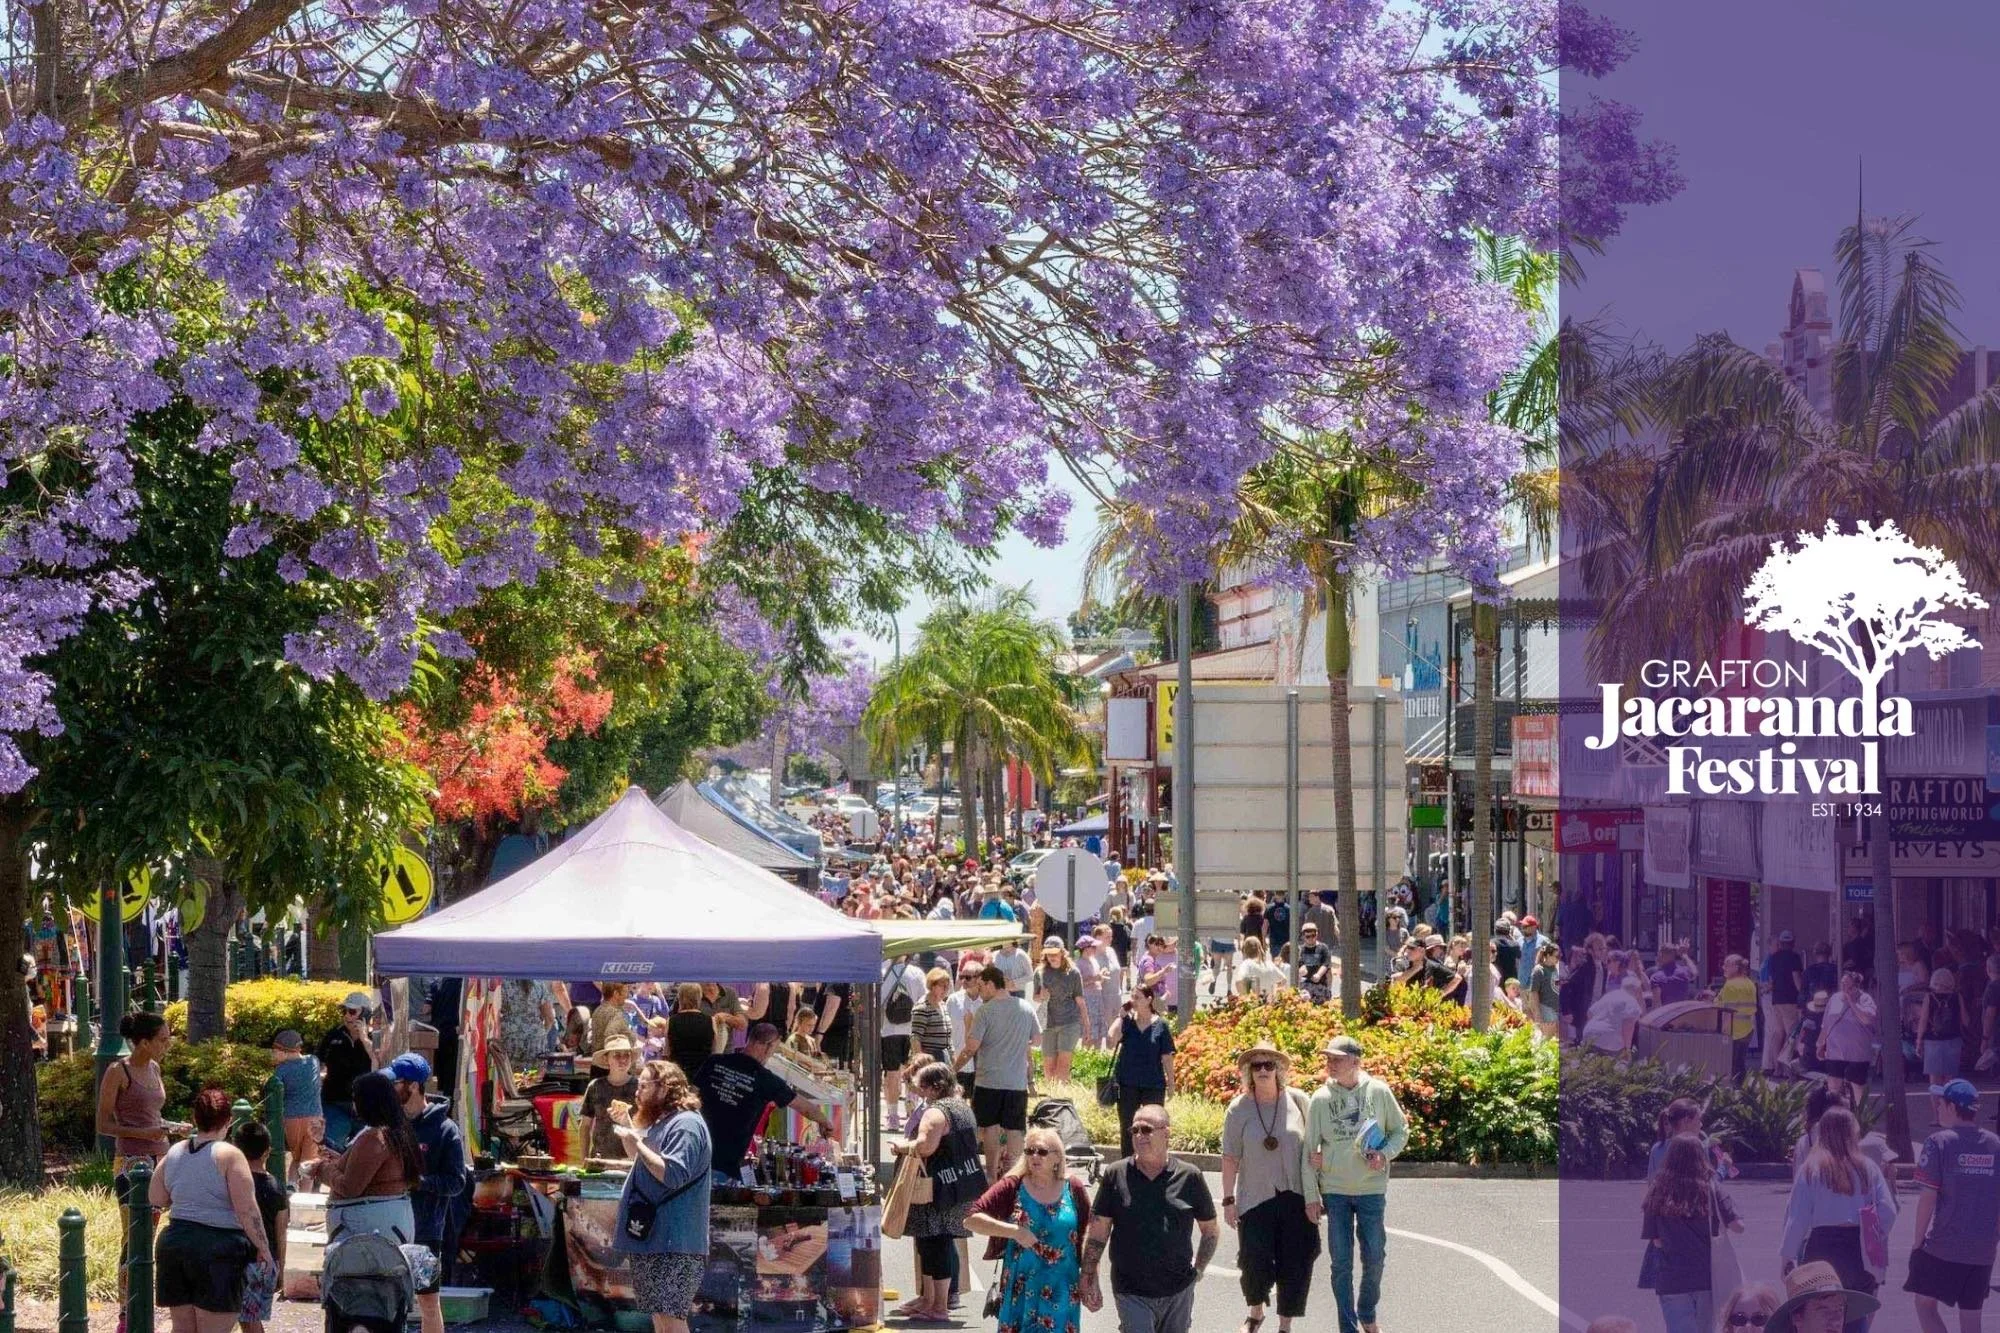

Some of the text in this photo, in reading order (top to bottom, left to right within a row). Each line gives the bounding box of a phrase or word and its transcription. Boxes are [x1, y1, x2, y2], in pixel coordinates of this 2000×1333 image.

[1891, 780, 1984, 804] RAFTON
[1890, 807, 1984, 820] OPPINGWORLD
[1851, 841, 1985, 858] HRVEYS
[603, 962, 653, 973] KINGS
[937, 1167, 958, 1185] YOU
[963, 1158, 980, 1176] ALL
